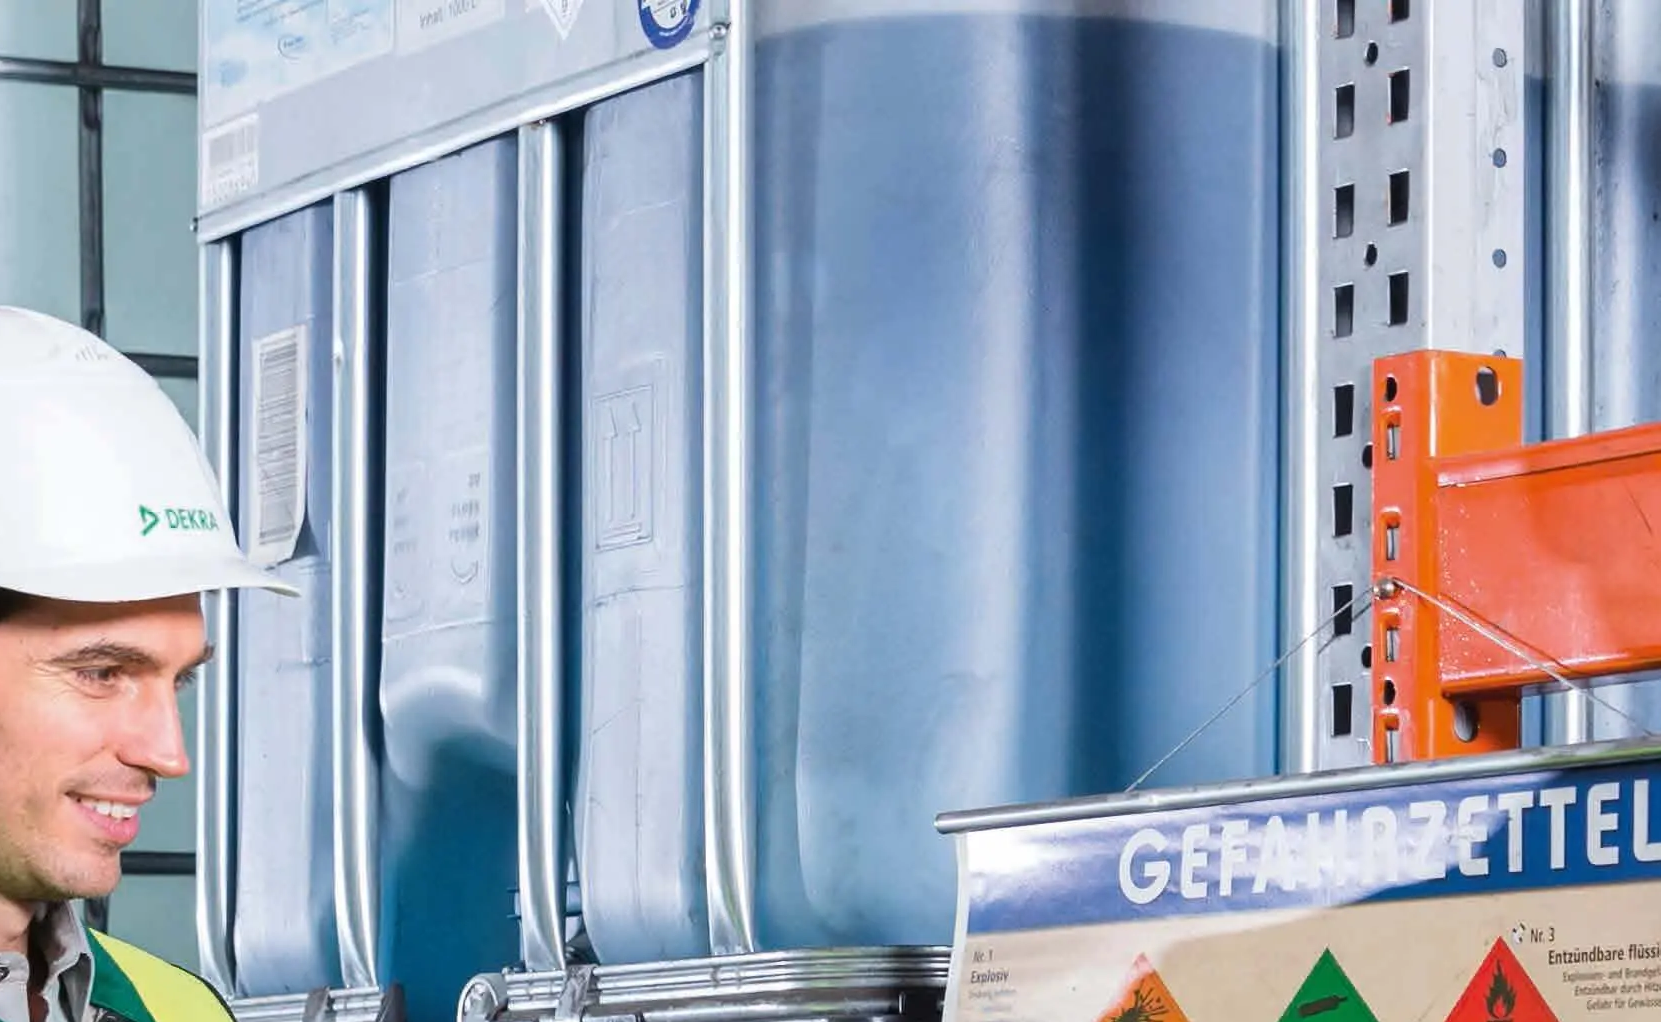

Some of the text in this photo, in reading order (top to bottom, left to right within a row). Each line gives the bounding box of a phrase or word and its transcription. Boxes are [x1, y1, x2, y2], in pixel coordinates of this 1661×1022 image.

[165, 508, 219, 531] DEKRA
[1118, 779, 1661, 905] GEFAHRZETTEL
[1530, 927, 1555, 943] Nr. 3
[989, 949, 994, 962] 1
[1548, 946, 1624, 965] Entzündbare
[970, 968, 1010, 984] Explosiv
